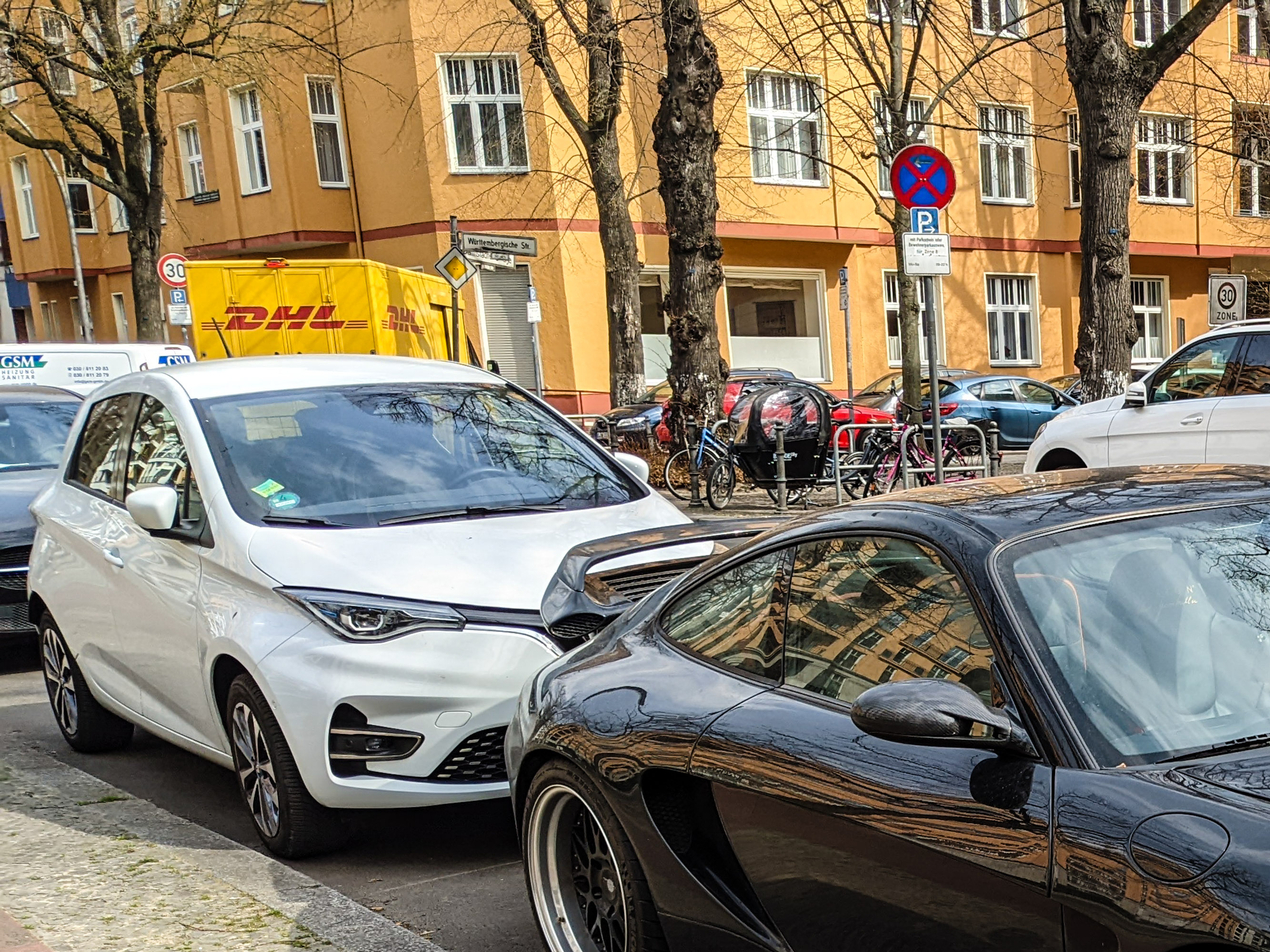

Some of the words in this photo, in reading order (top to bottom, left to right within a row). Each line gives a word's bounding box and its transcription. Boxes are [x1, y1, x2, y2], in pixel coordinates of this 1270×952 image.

[918, 212, 932, 233] P
[467, 237, 519, 250] Württembergische
[521, 241, 531, 250] Str.
[166, 263, 185, 278] 30
[1221, 290, 1232, 302] 30
[224, 304, 346, 331] DHL
[386, 304, 420, 334] DHL
[1216, 312, 1236, 320] ZONE
[0, 356, 35, 368] GSM
